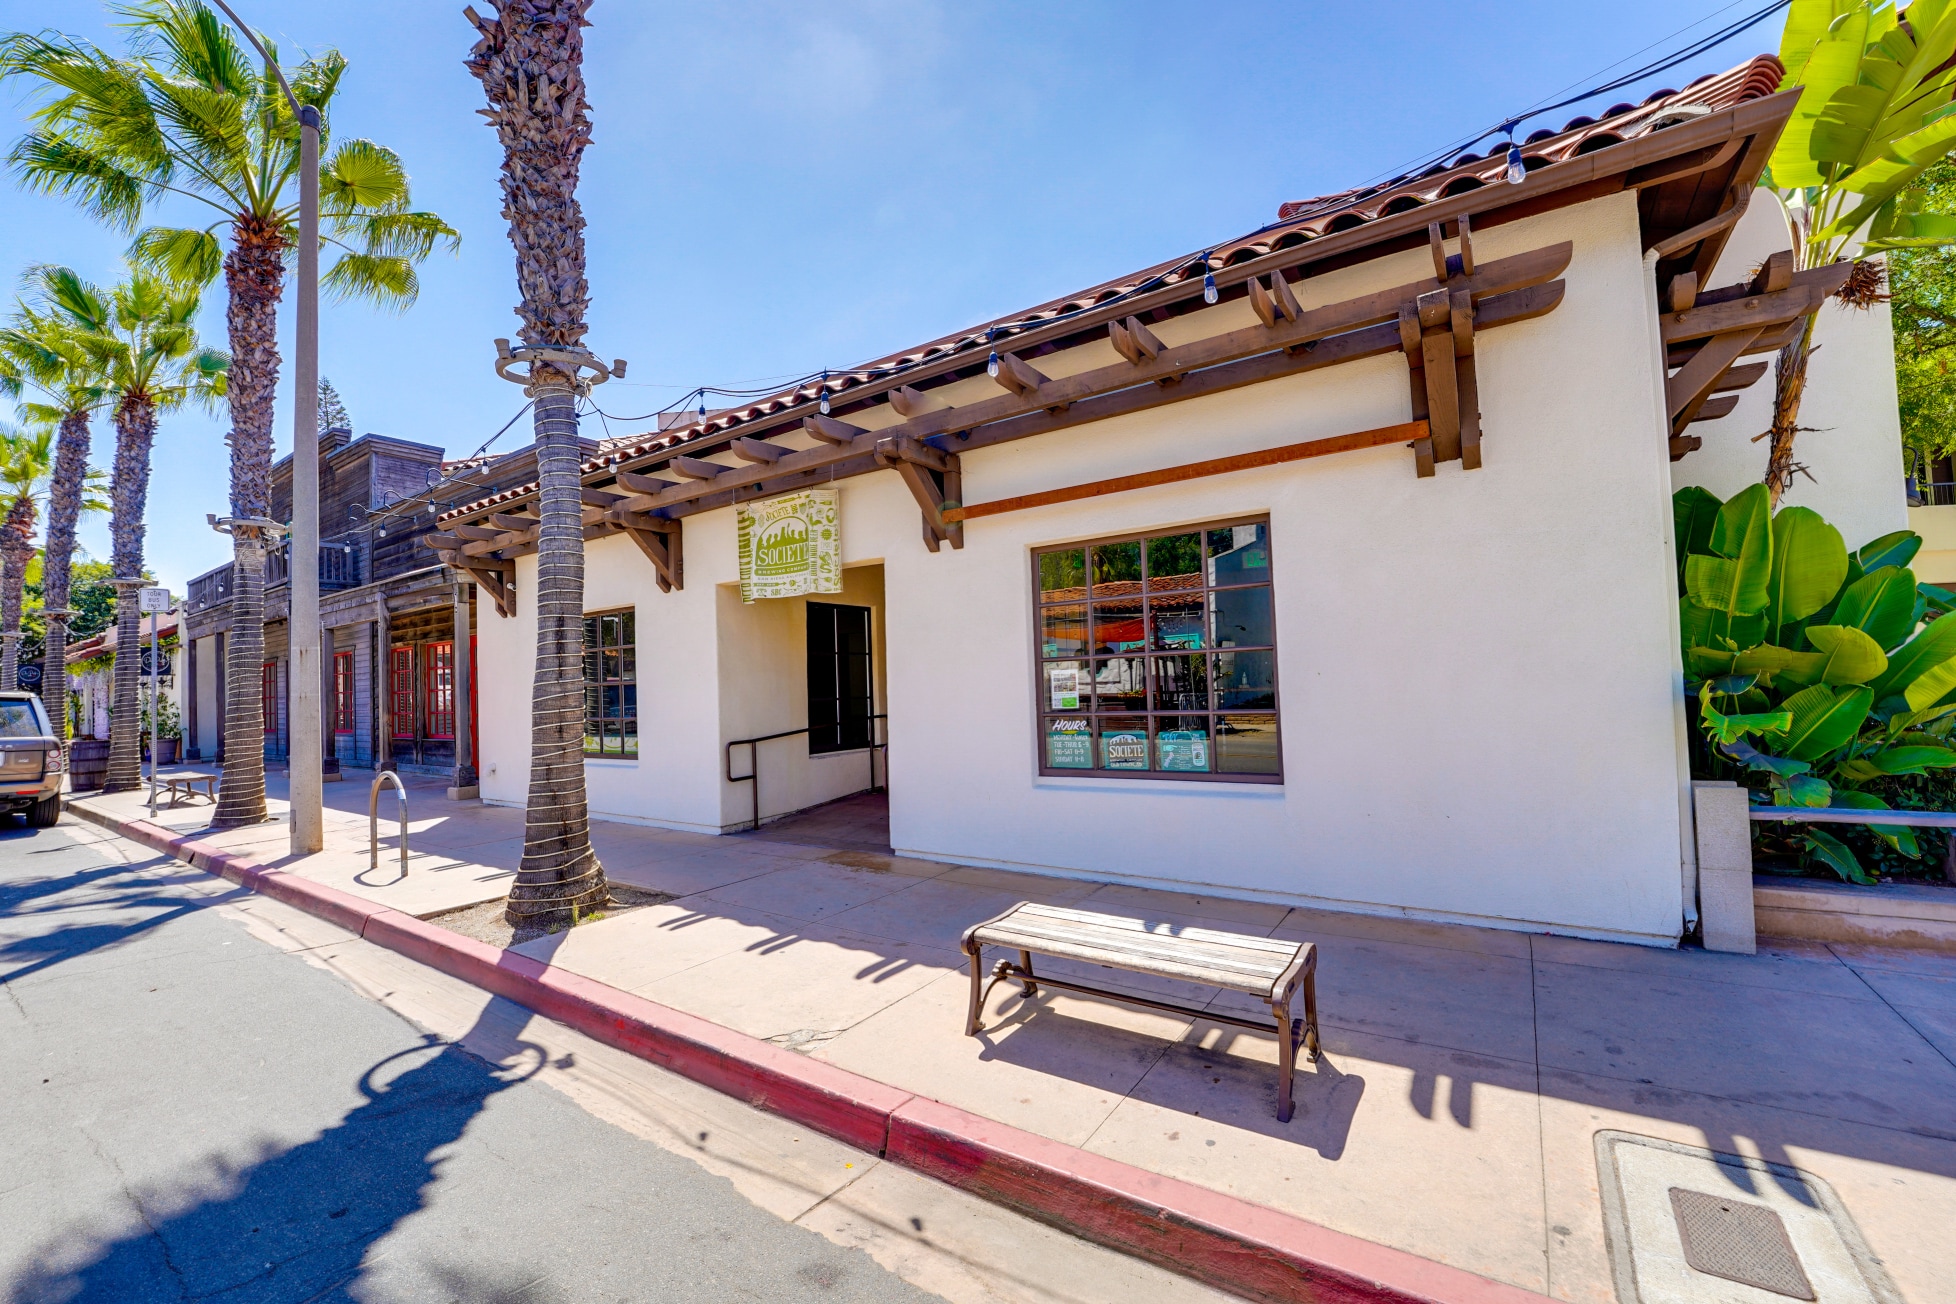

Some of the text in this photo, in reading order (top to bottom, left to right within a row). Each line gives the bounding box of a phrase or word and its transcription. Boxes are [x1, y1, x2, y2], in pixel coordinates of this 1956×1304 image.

[757, 542, 808, 566] SOCIETE
[1052, 718, 1087, 731] HOURS
[1108, 744, 1145, 758] SOCIETE
